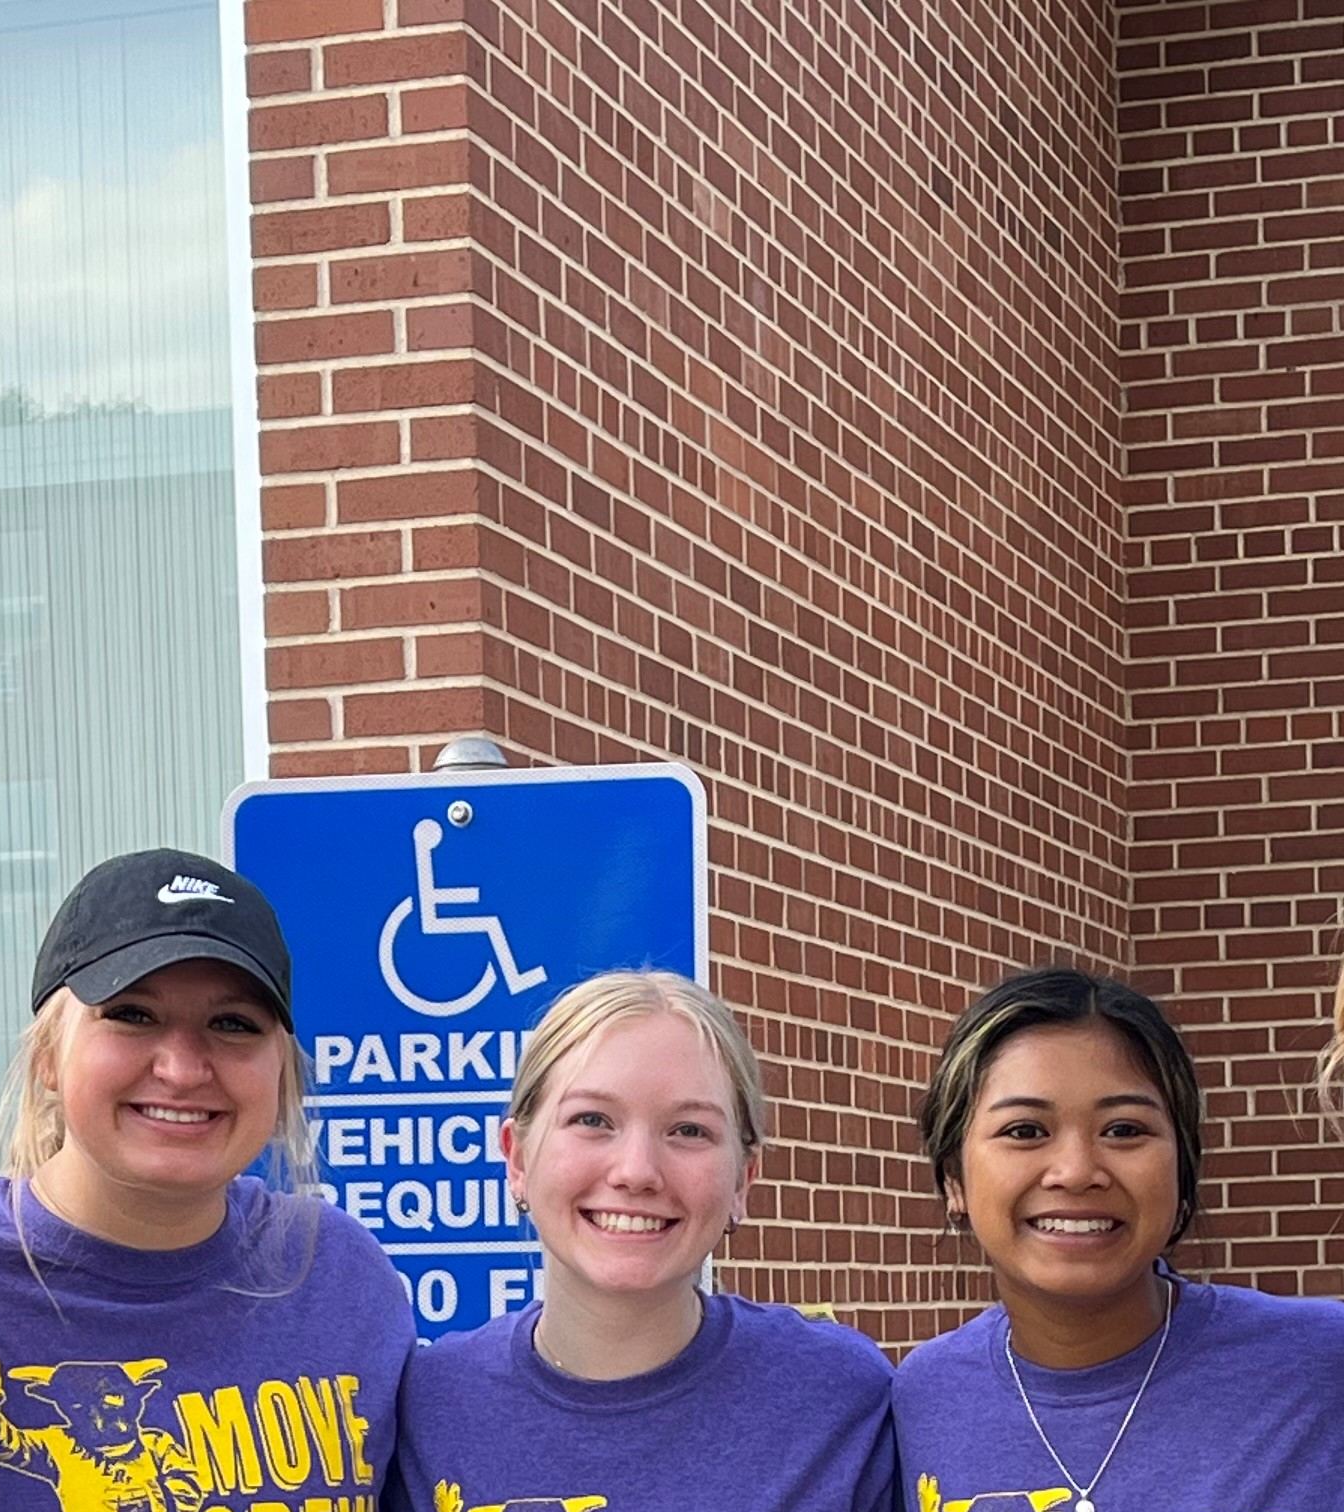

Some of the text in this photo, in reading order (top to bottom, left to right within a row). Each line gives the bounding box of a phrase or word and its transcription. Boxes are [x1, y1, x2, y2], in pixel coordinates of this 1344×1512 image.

[170, 875, 220, 894] NIKE
[315, 1030, 529, 1084] PARKI
[173, 1375, 373, 1495] MOVE
